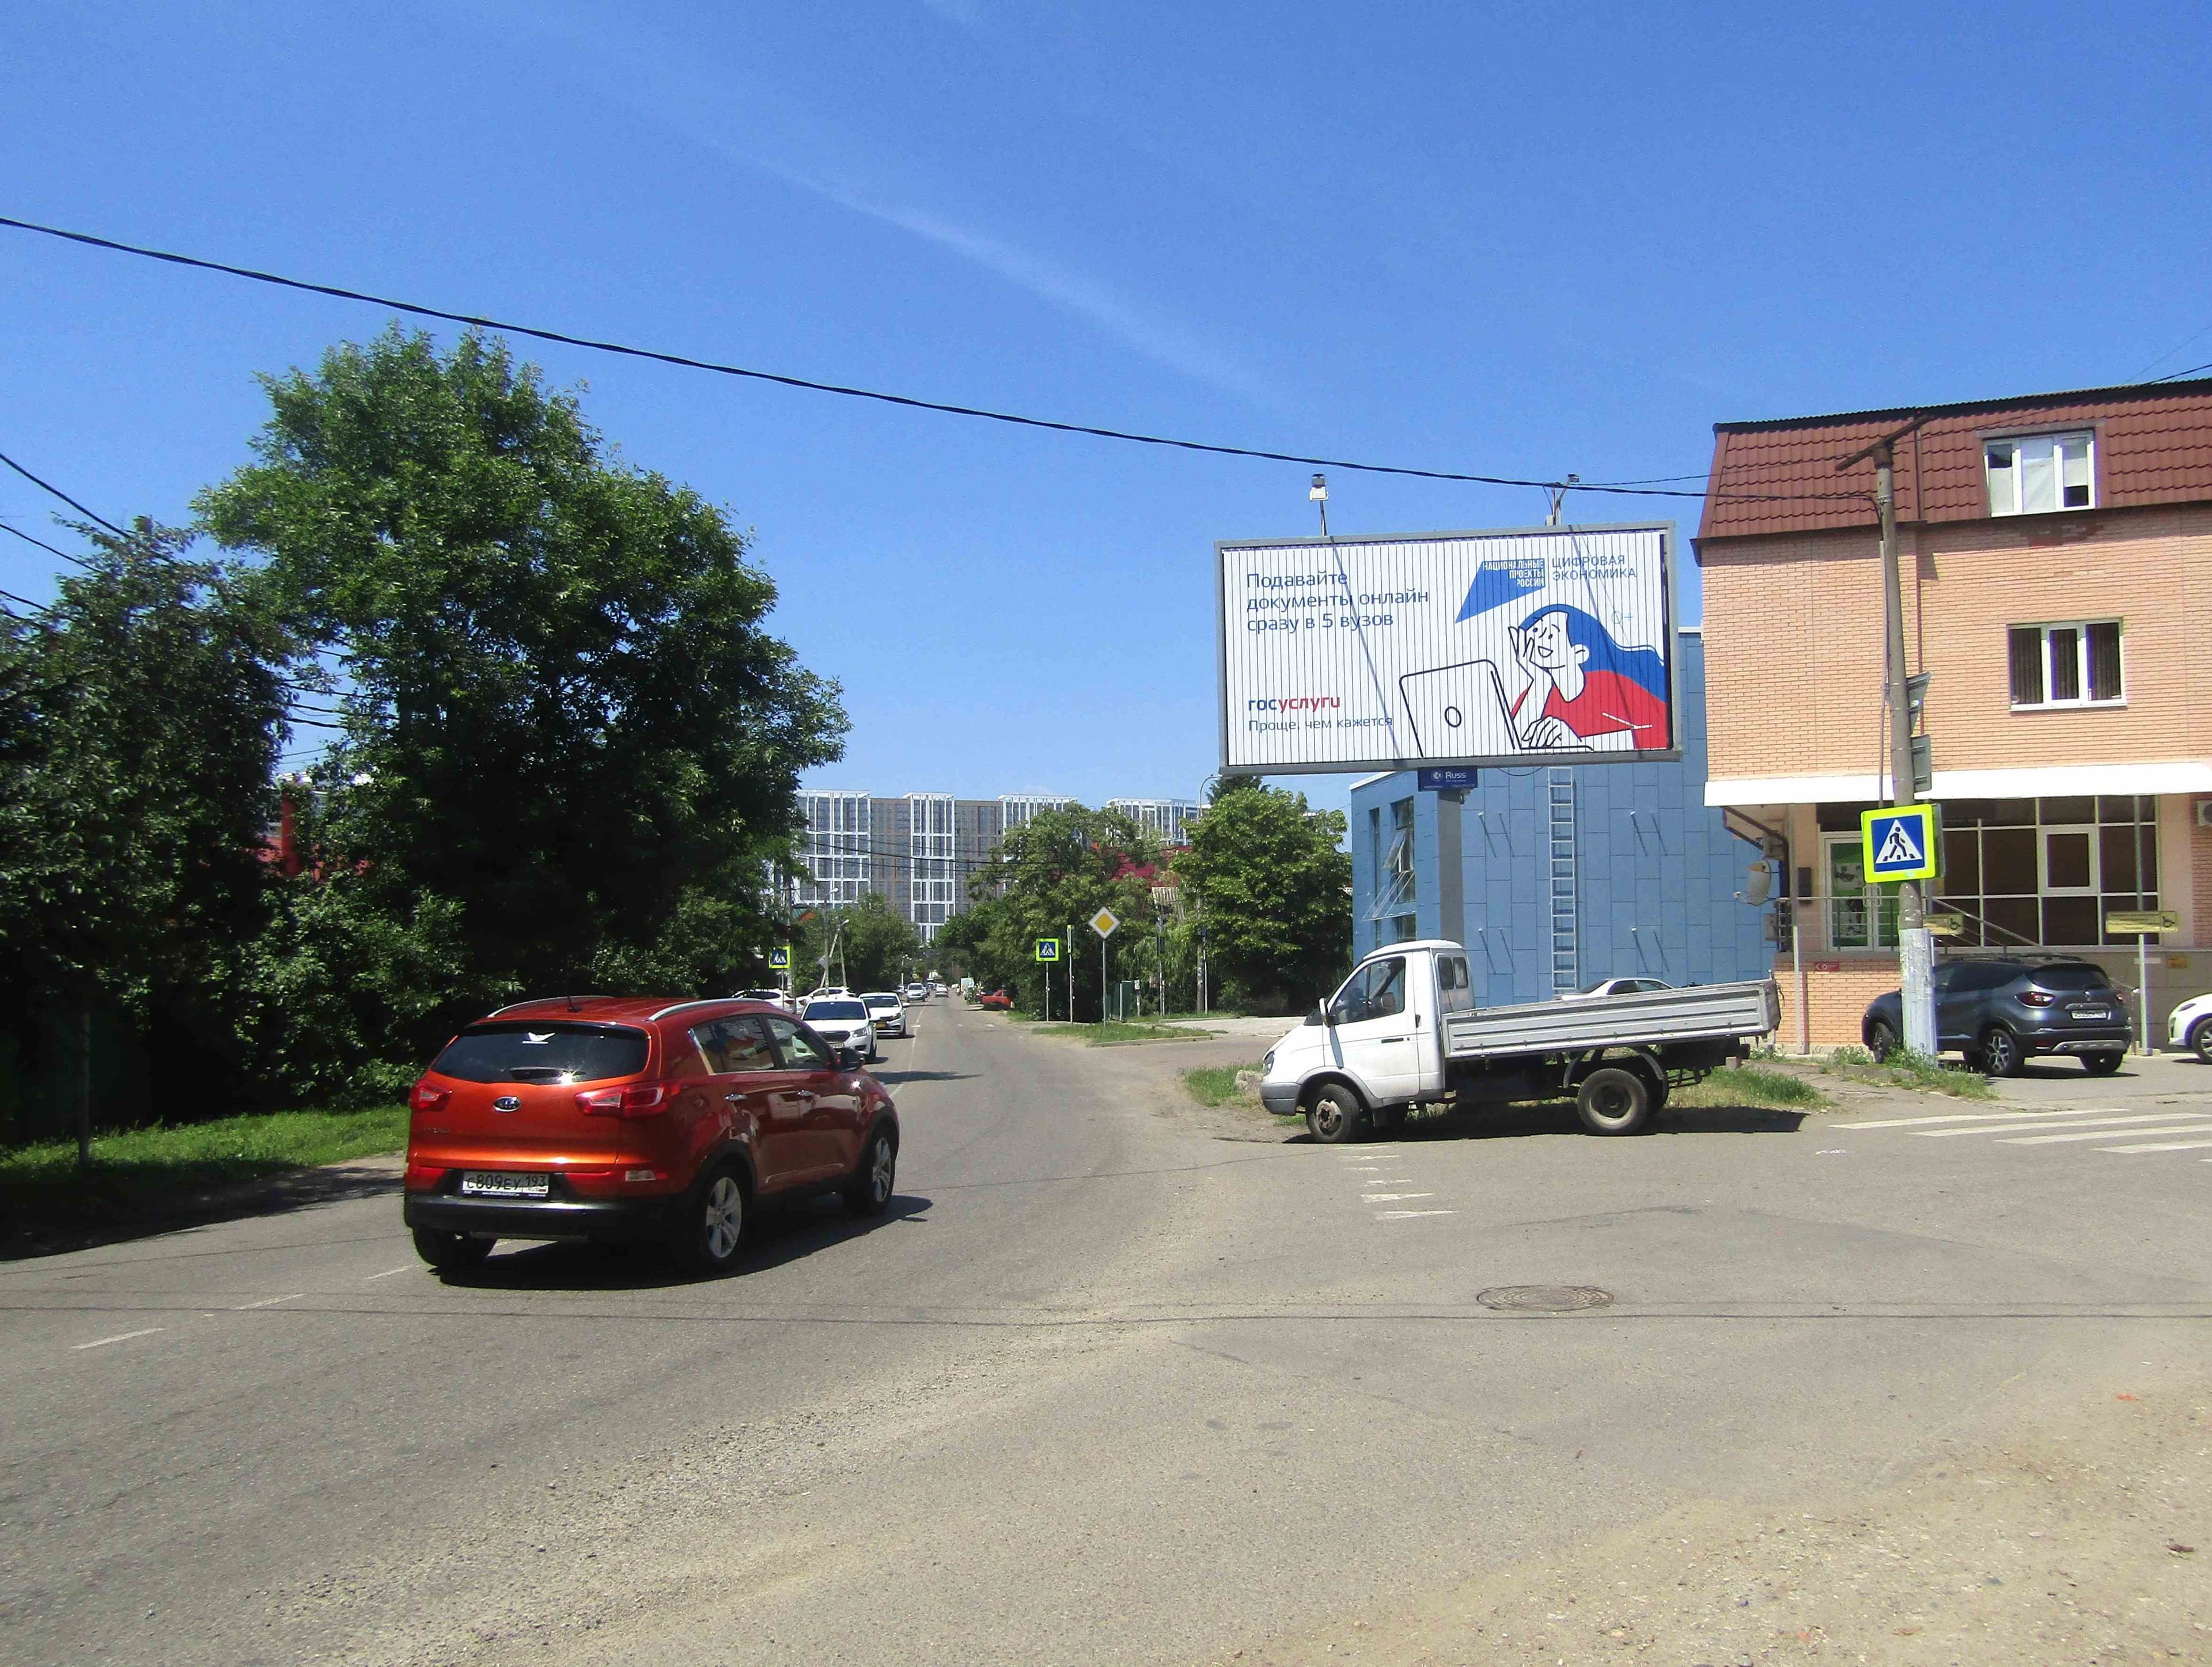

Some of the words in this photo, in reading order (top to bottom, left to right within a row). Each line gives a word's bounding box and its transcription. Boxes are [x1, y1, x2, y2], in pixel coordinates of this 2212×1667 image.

[1482, 559, 1544, 571] НАЦИОНАЛЬНЫЕ
[1552, 555, 1625, 570] ЦИФРОВАЯ
[1247, 570, 1348, 590] Подавайте
[1509, 569, 1544, 579] ПРОЕКТЫ
[1552, 568, 1637, 581] ЭКОНОМИКА
[1517, 577, 1544, 588] РОССИИ
[1247, 593, 1353, 613] документы
[1359, 588, 1429, 605] онлайн
[1247, 617, 1299, 634] сразу
[1305, 617, 1315, 629] в
[1322, 613, 1334, 628] 5
[1340, 613, 1394, 631] вузов
[1248, 696, 1341, 714] госуслуги
[1248, 720, 1300, 733] Проще,
[1305, 719, 1332, 729] чем
[1336, 717, 1393, 728] кажется
[1445, 771, 1466, 779] Russ
